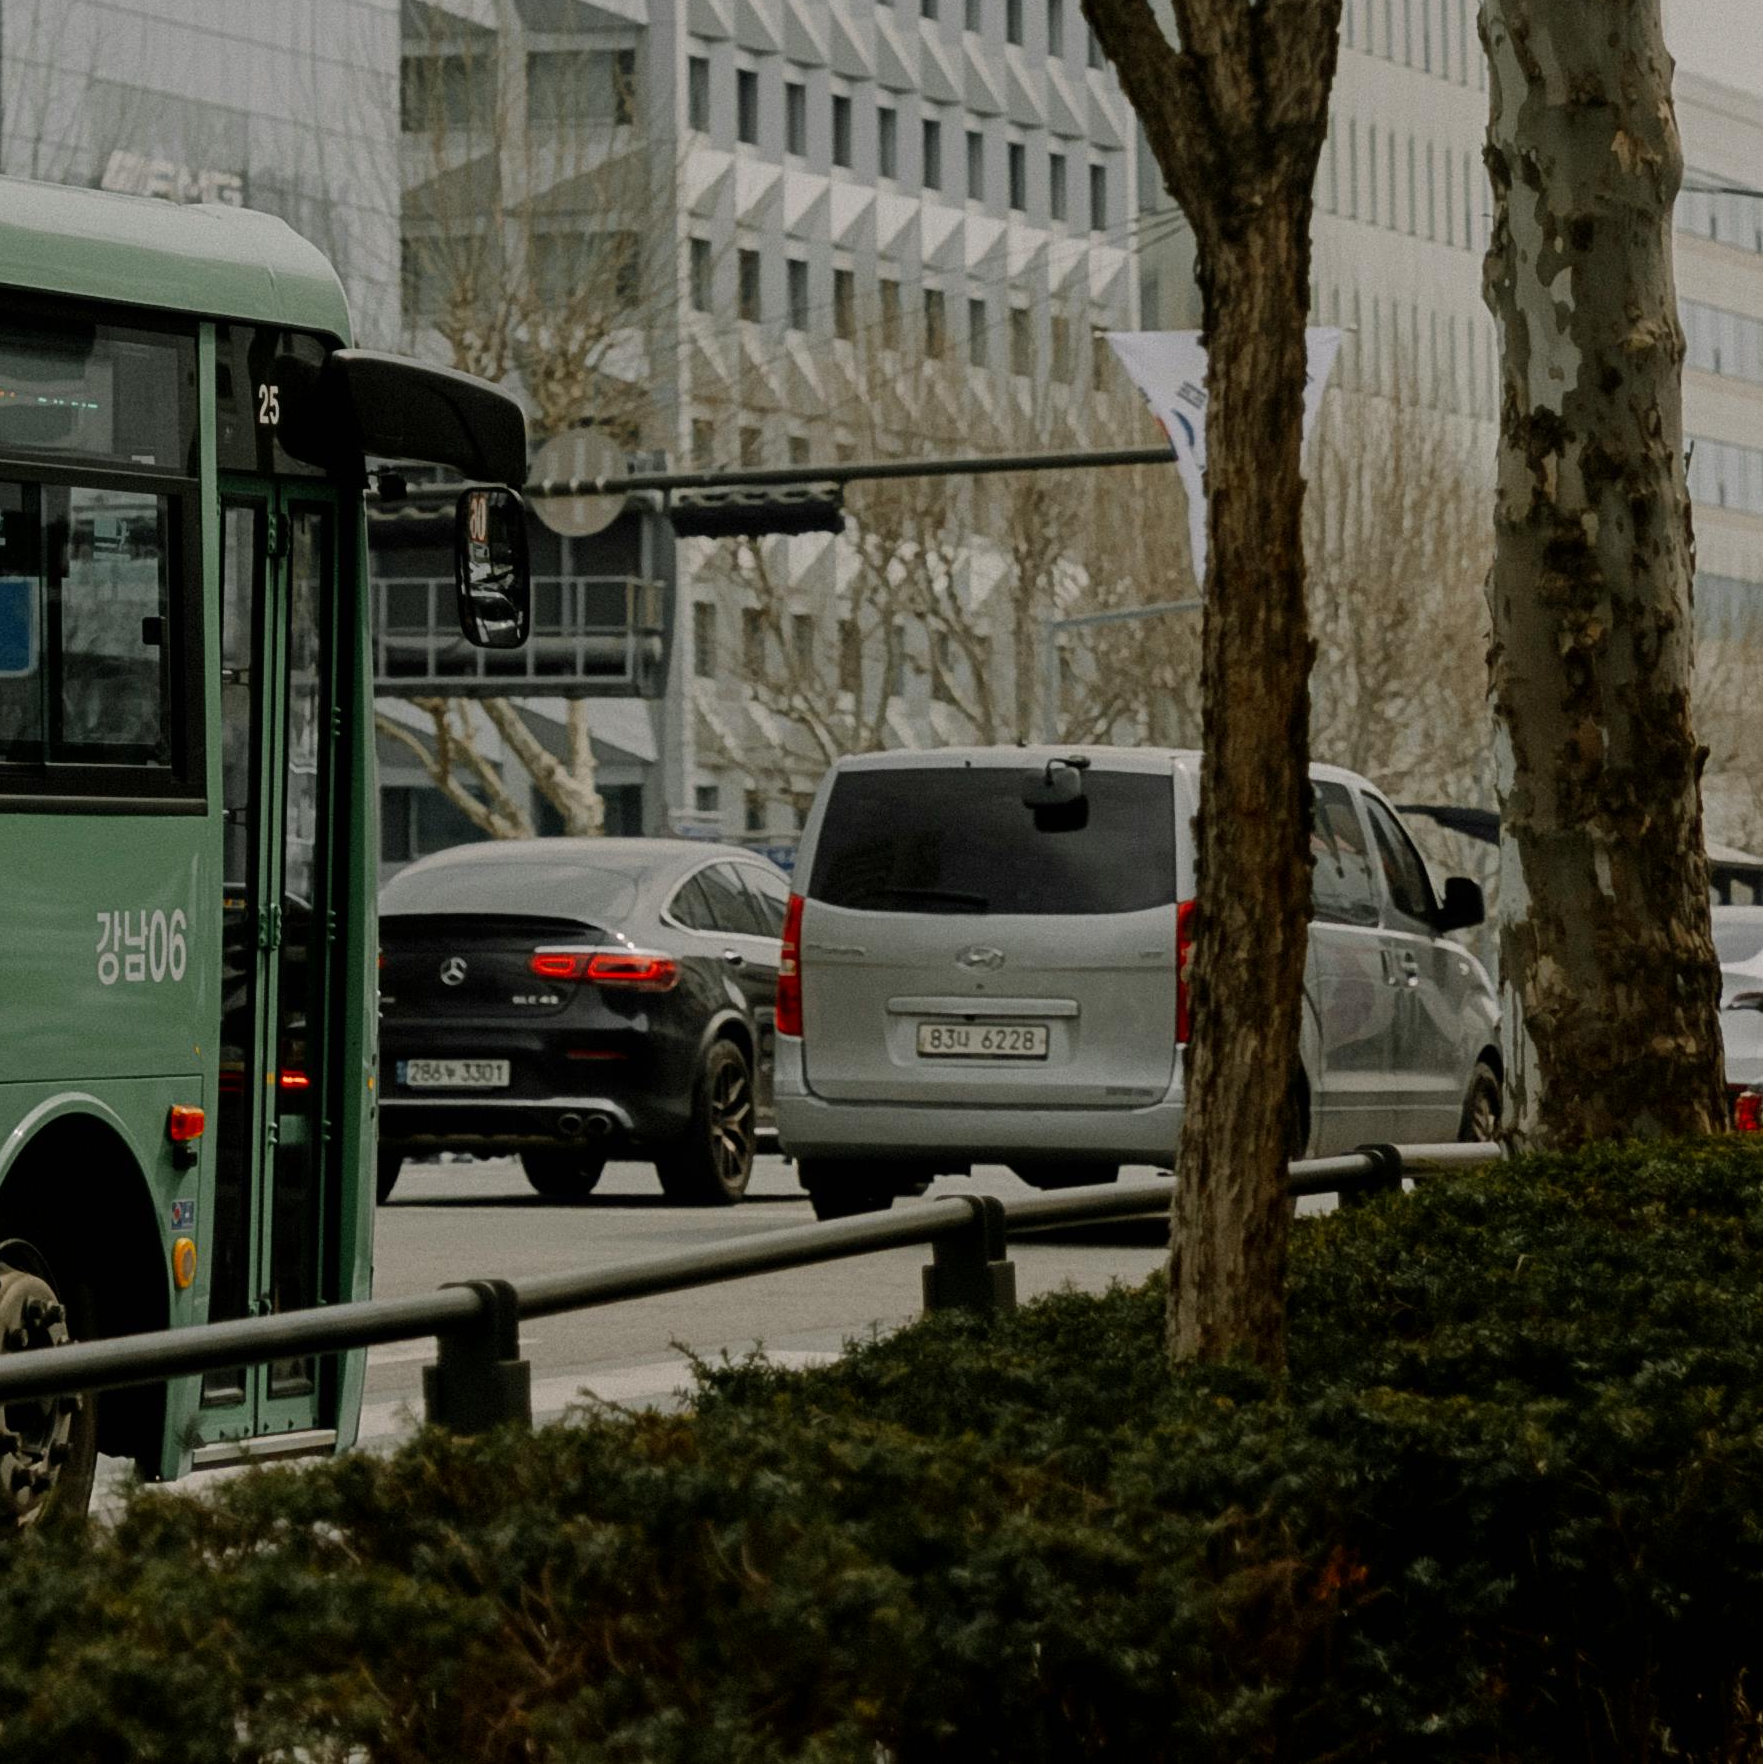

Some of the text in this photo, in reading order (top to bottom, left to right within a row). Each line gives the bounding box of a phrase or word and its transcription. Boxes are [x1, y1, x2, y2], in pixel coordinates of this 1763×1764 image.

[257, 382, 281, 426] 25
[94, 907, 189, 986] 강남06
[980, 1029, 1036, 1051] 6228
